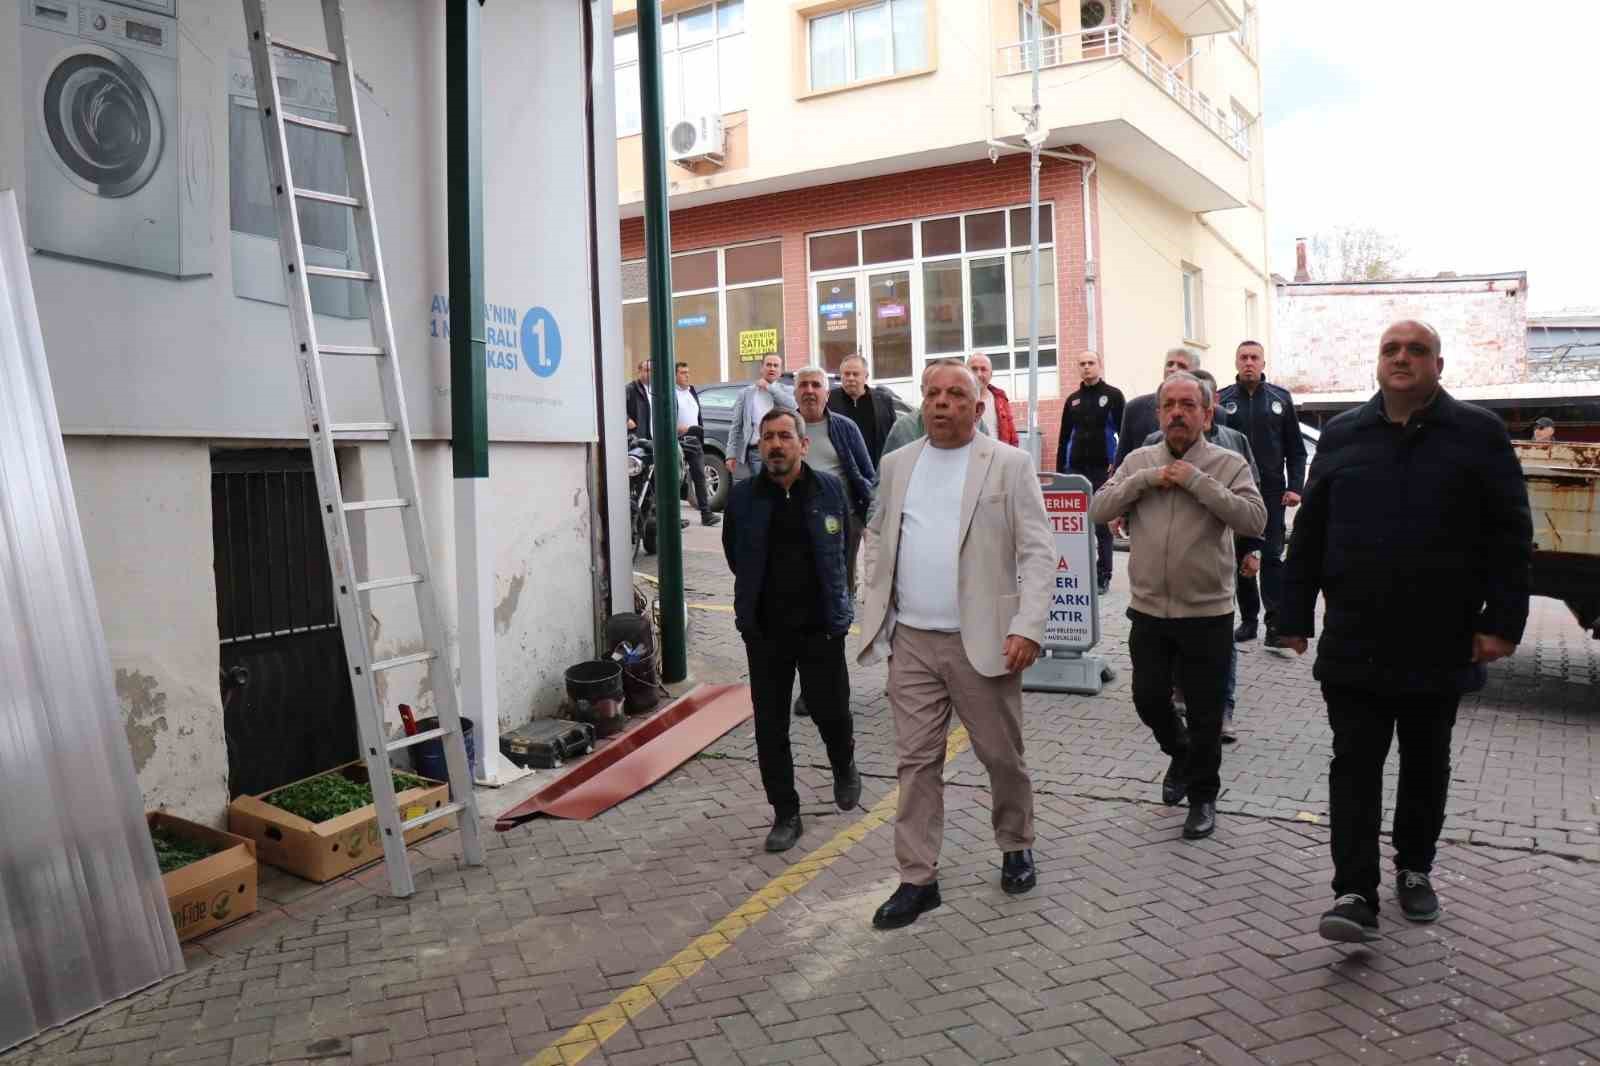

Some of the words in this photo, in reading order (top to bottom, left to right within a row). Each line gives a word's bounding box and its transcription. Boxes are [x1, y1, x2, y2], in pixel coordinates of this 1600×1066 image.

[742, 339, 775, 348] SATILIK
[1045, 496, 1081, 509] ERİNE
[1048, 512, 1083, 531] TESİ
[1047, 611, 1083, 622] KTIR
